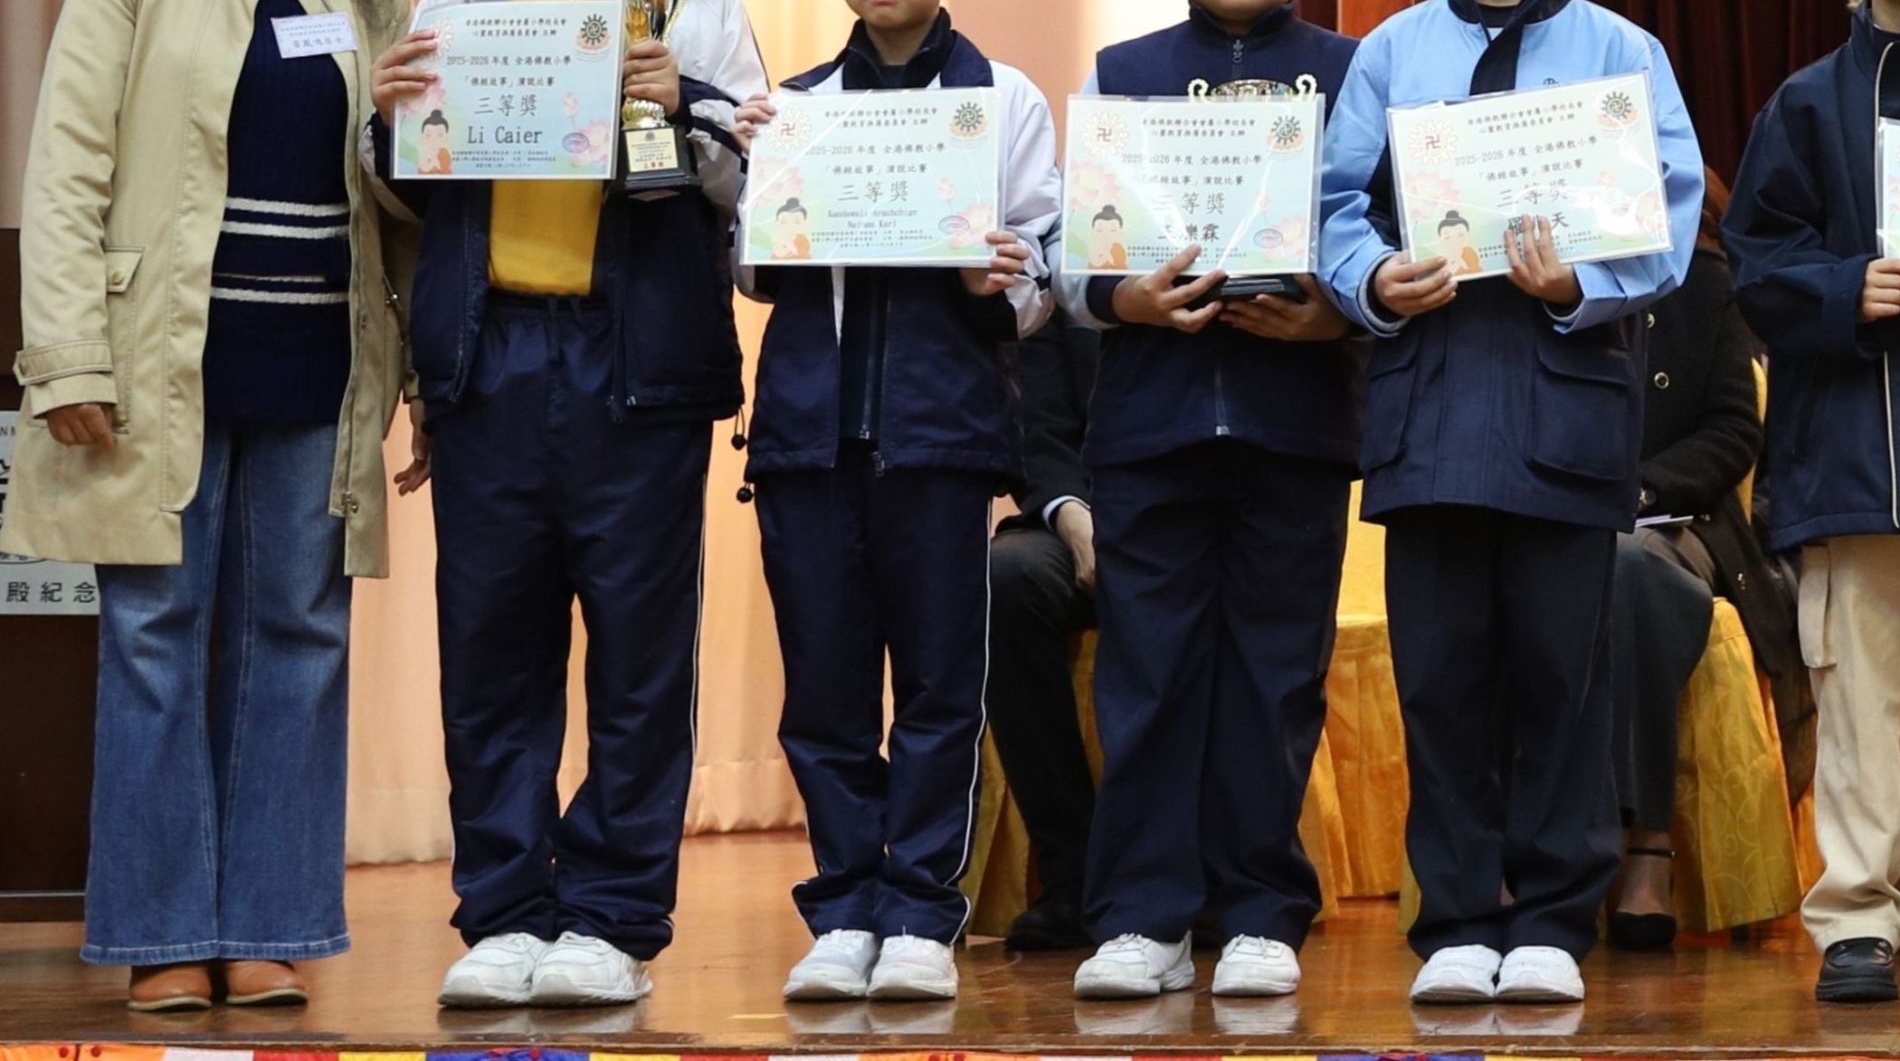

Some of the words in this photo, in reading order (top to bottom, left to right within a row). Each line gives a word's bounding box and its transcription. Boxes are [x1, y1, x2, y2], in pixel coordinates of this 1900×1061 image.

[474, 94, 537, 117] 三等獎
[467, 126, 484, 144] Li
[495, 126, 543, 144] Caier
[837, 181, 909, 203] 三等獎
